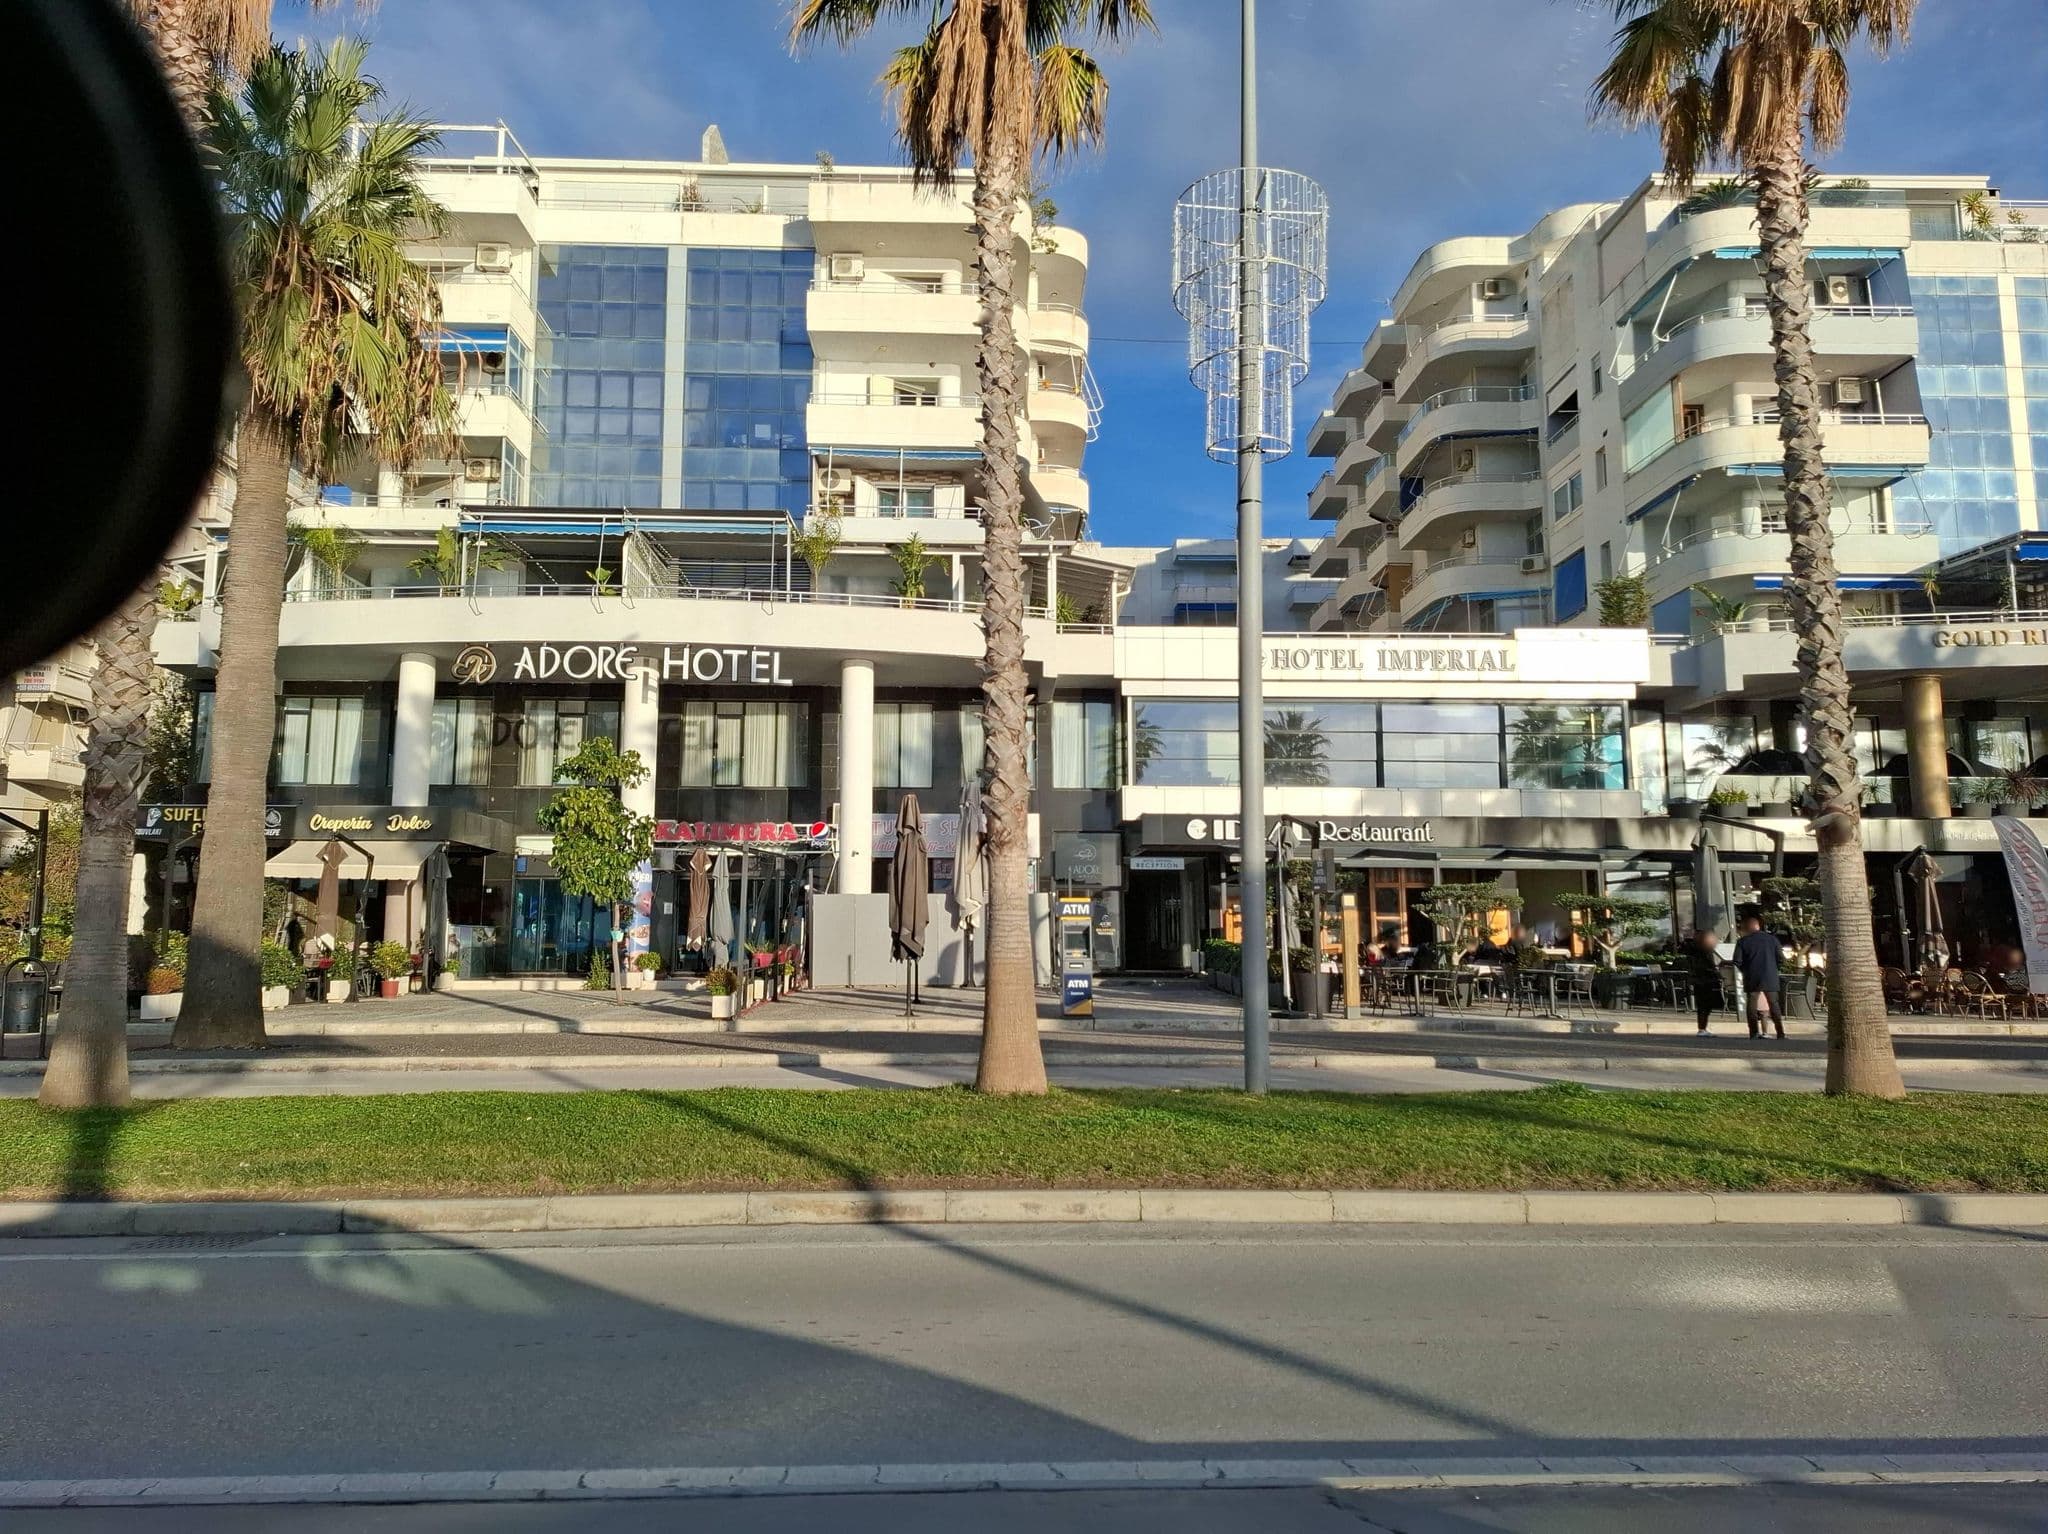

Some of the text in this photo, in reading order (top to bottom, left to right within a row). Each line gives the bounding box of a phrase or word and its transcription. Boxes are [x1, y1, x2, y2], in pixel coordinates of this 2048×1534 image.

[1934, 631, 2008, 648] GOLD
[513, 646, 793, 684] ADORE HOTEL
[1270, 648, 1516, 673] HOTEL IMPERIAL
[310, 813, 432, 832] Creperia Dolce
[655, 821, 798, 842] KALIMERA
[1318, 820, 1434, 842] Restaurant
[1062, 904, 1090, 915] ATM
[1067, 980, 1089, 989] ATM
